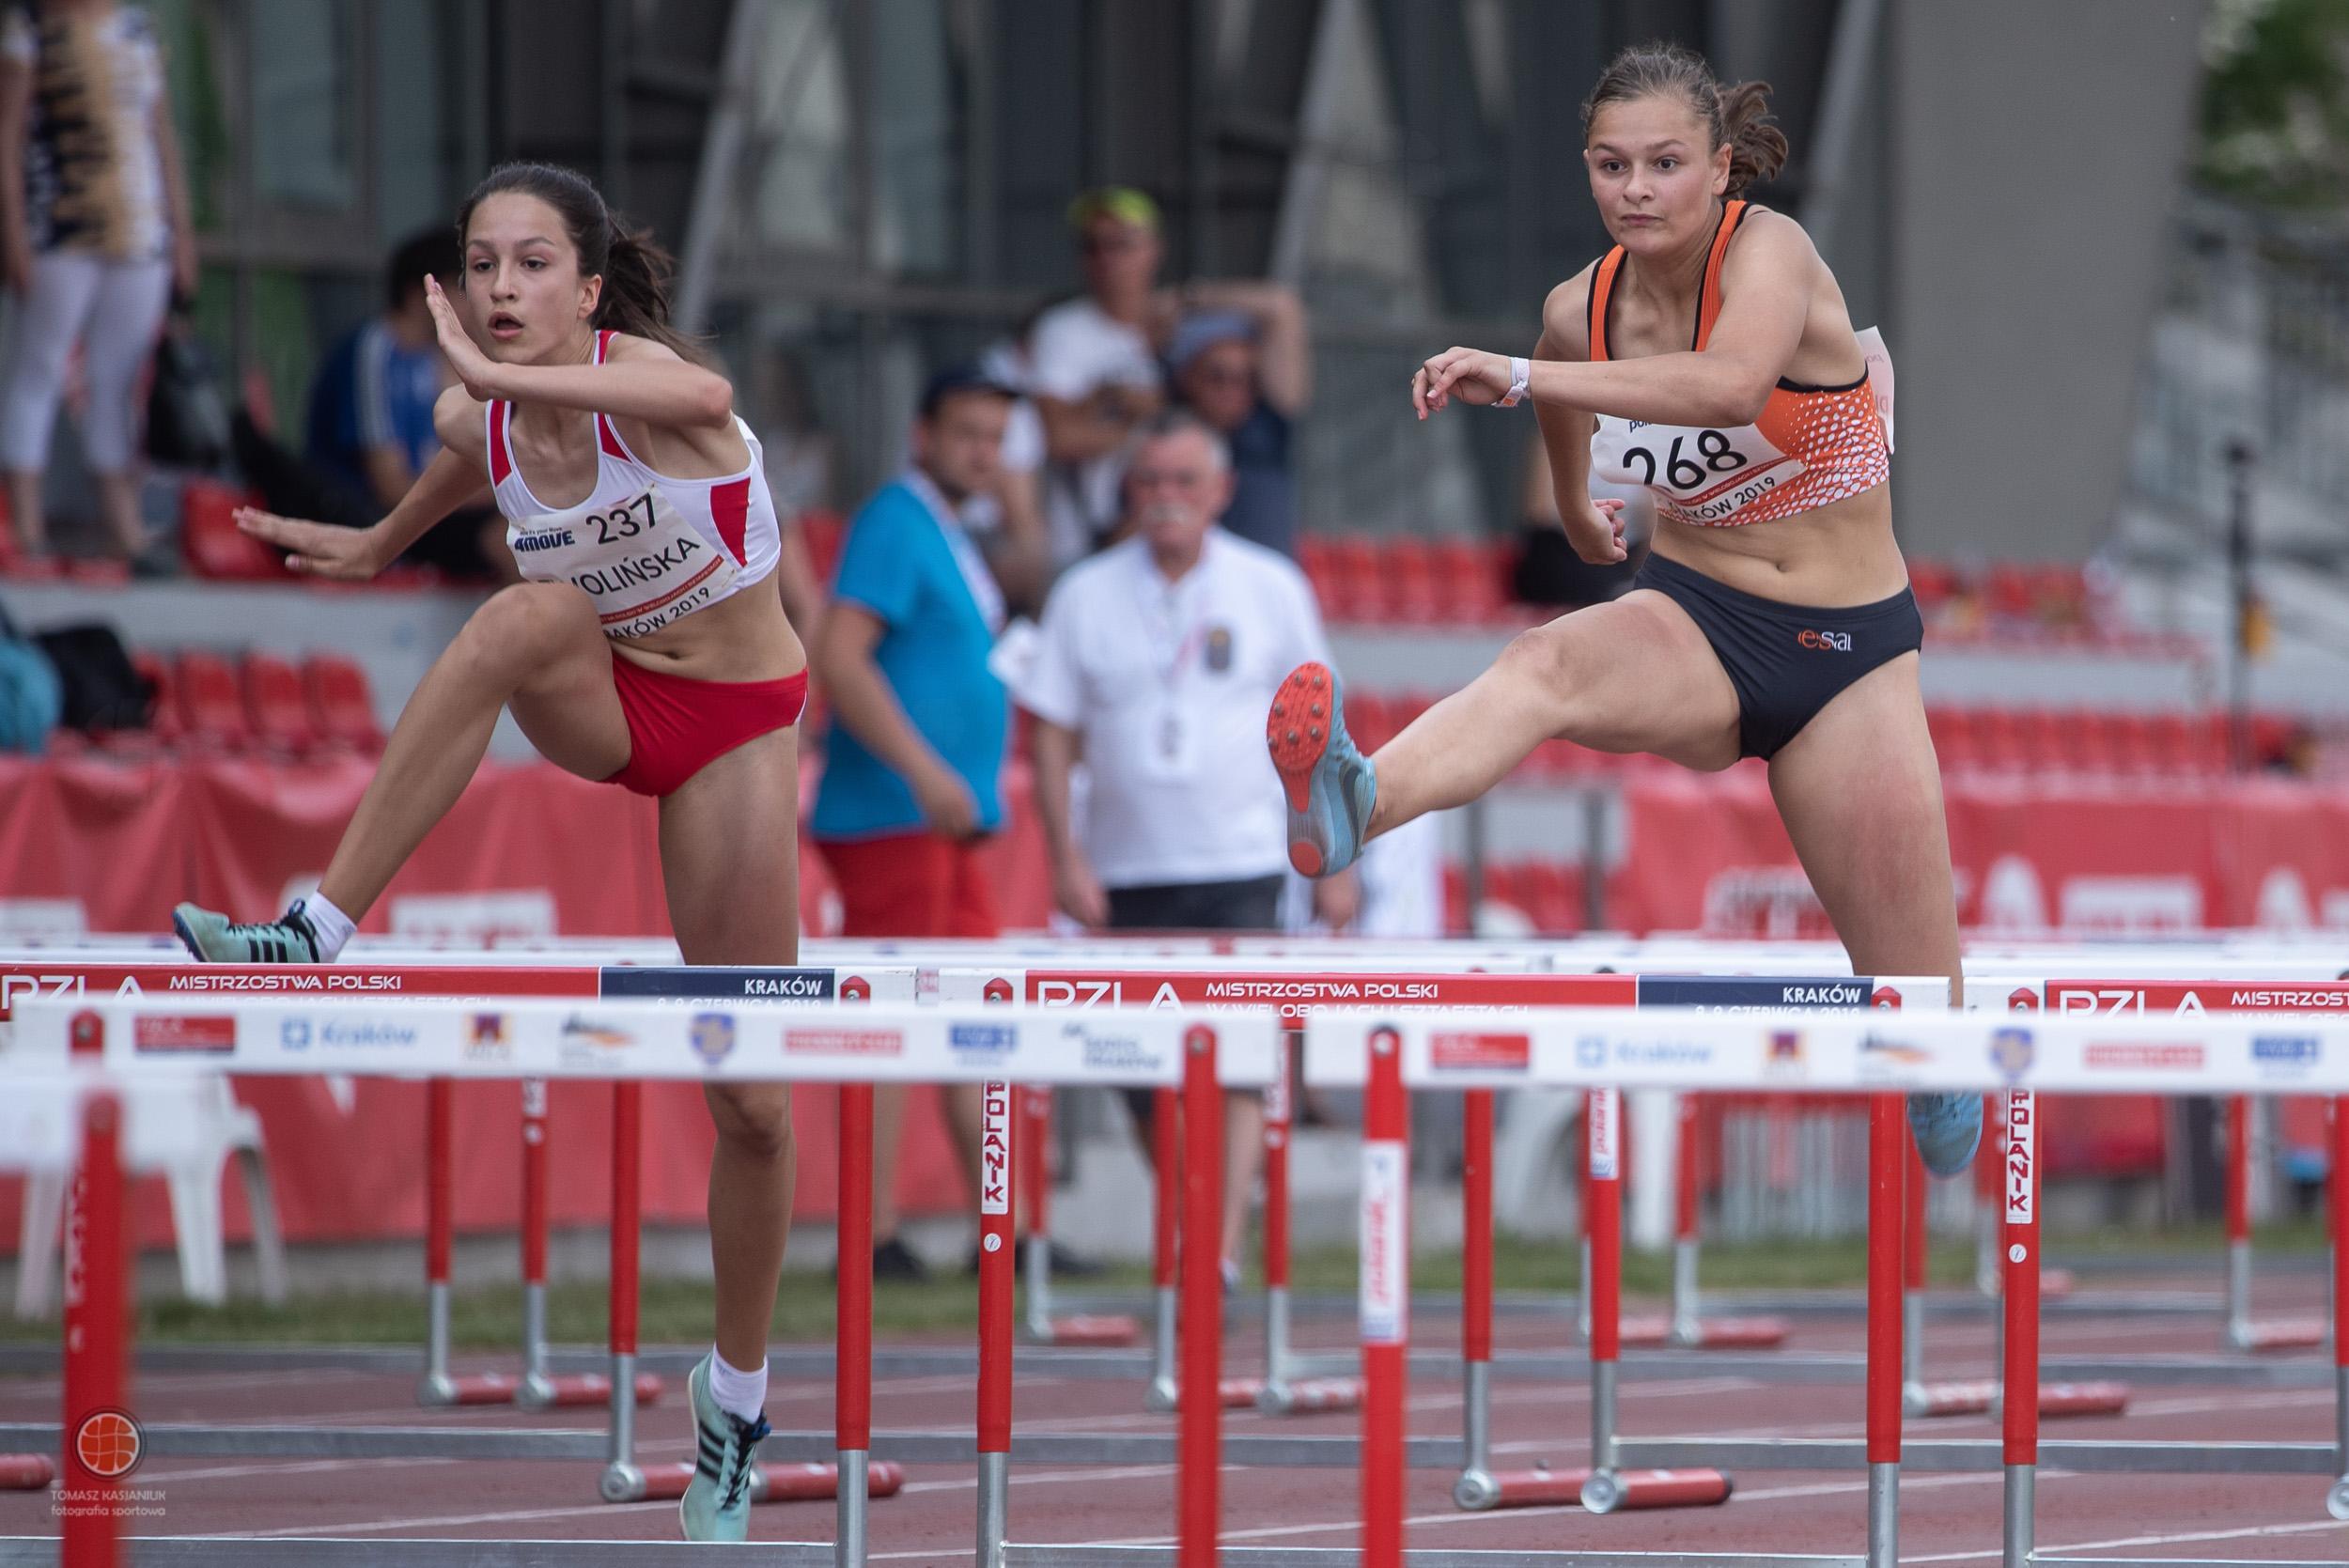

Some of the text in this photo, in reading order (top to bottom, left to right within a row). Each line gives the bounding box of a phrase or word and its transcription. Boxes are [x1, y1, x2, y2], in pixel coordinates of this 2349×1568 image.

[1623, 429, 1748, 493] 268
[1735, 476, 1775, 505] 2019
[585, 492, 657, 545] 237
[569, 536, 701, 597] OLIŃSKA
[670, 586, 710, 618] 2019
[169, 975, 402, 990] MISTRZOSTWA POLSKI
[744, 975, 823, 996] KRAKÓW
[1206, 982, 1439, 999] MISTRZOSTWA POLSKI
[1782, 983, 1861, 1004] KRAKÓW
[984, 1081, 1006, 1203] POLANIK
[2008, 1088, 2030, 1212] POLANIK
